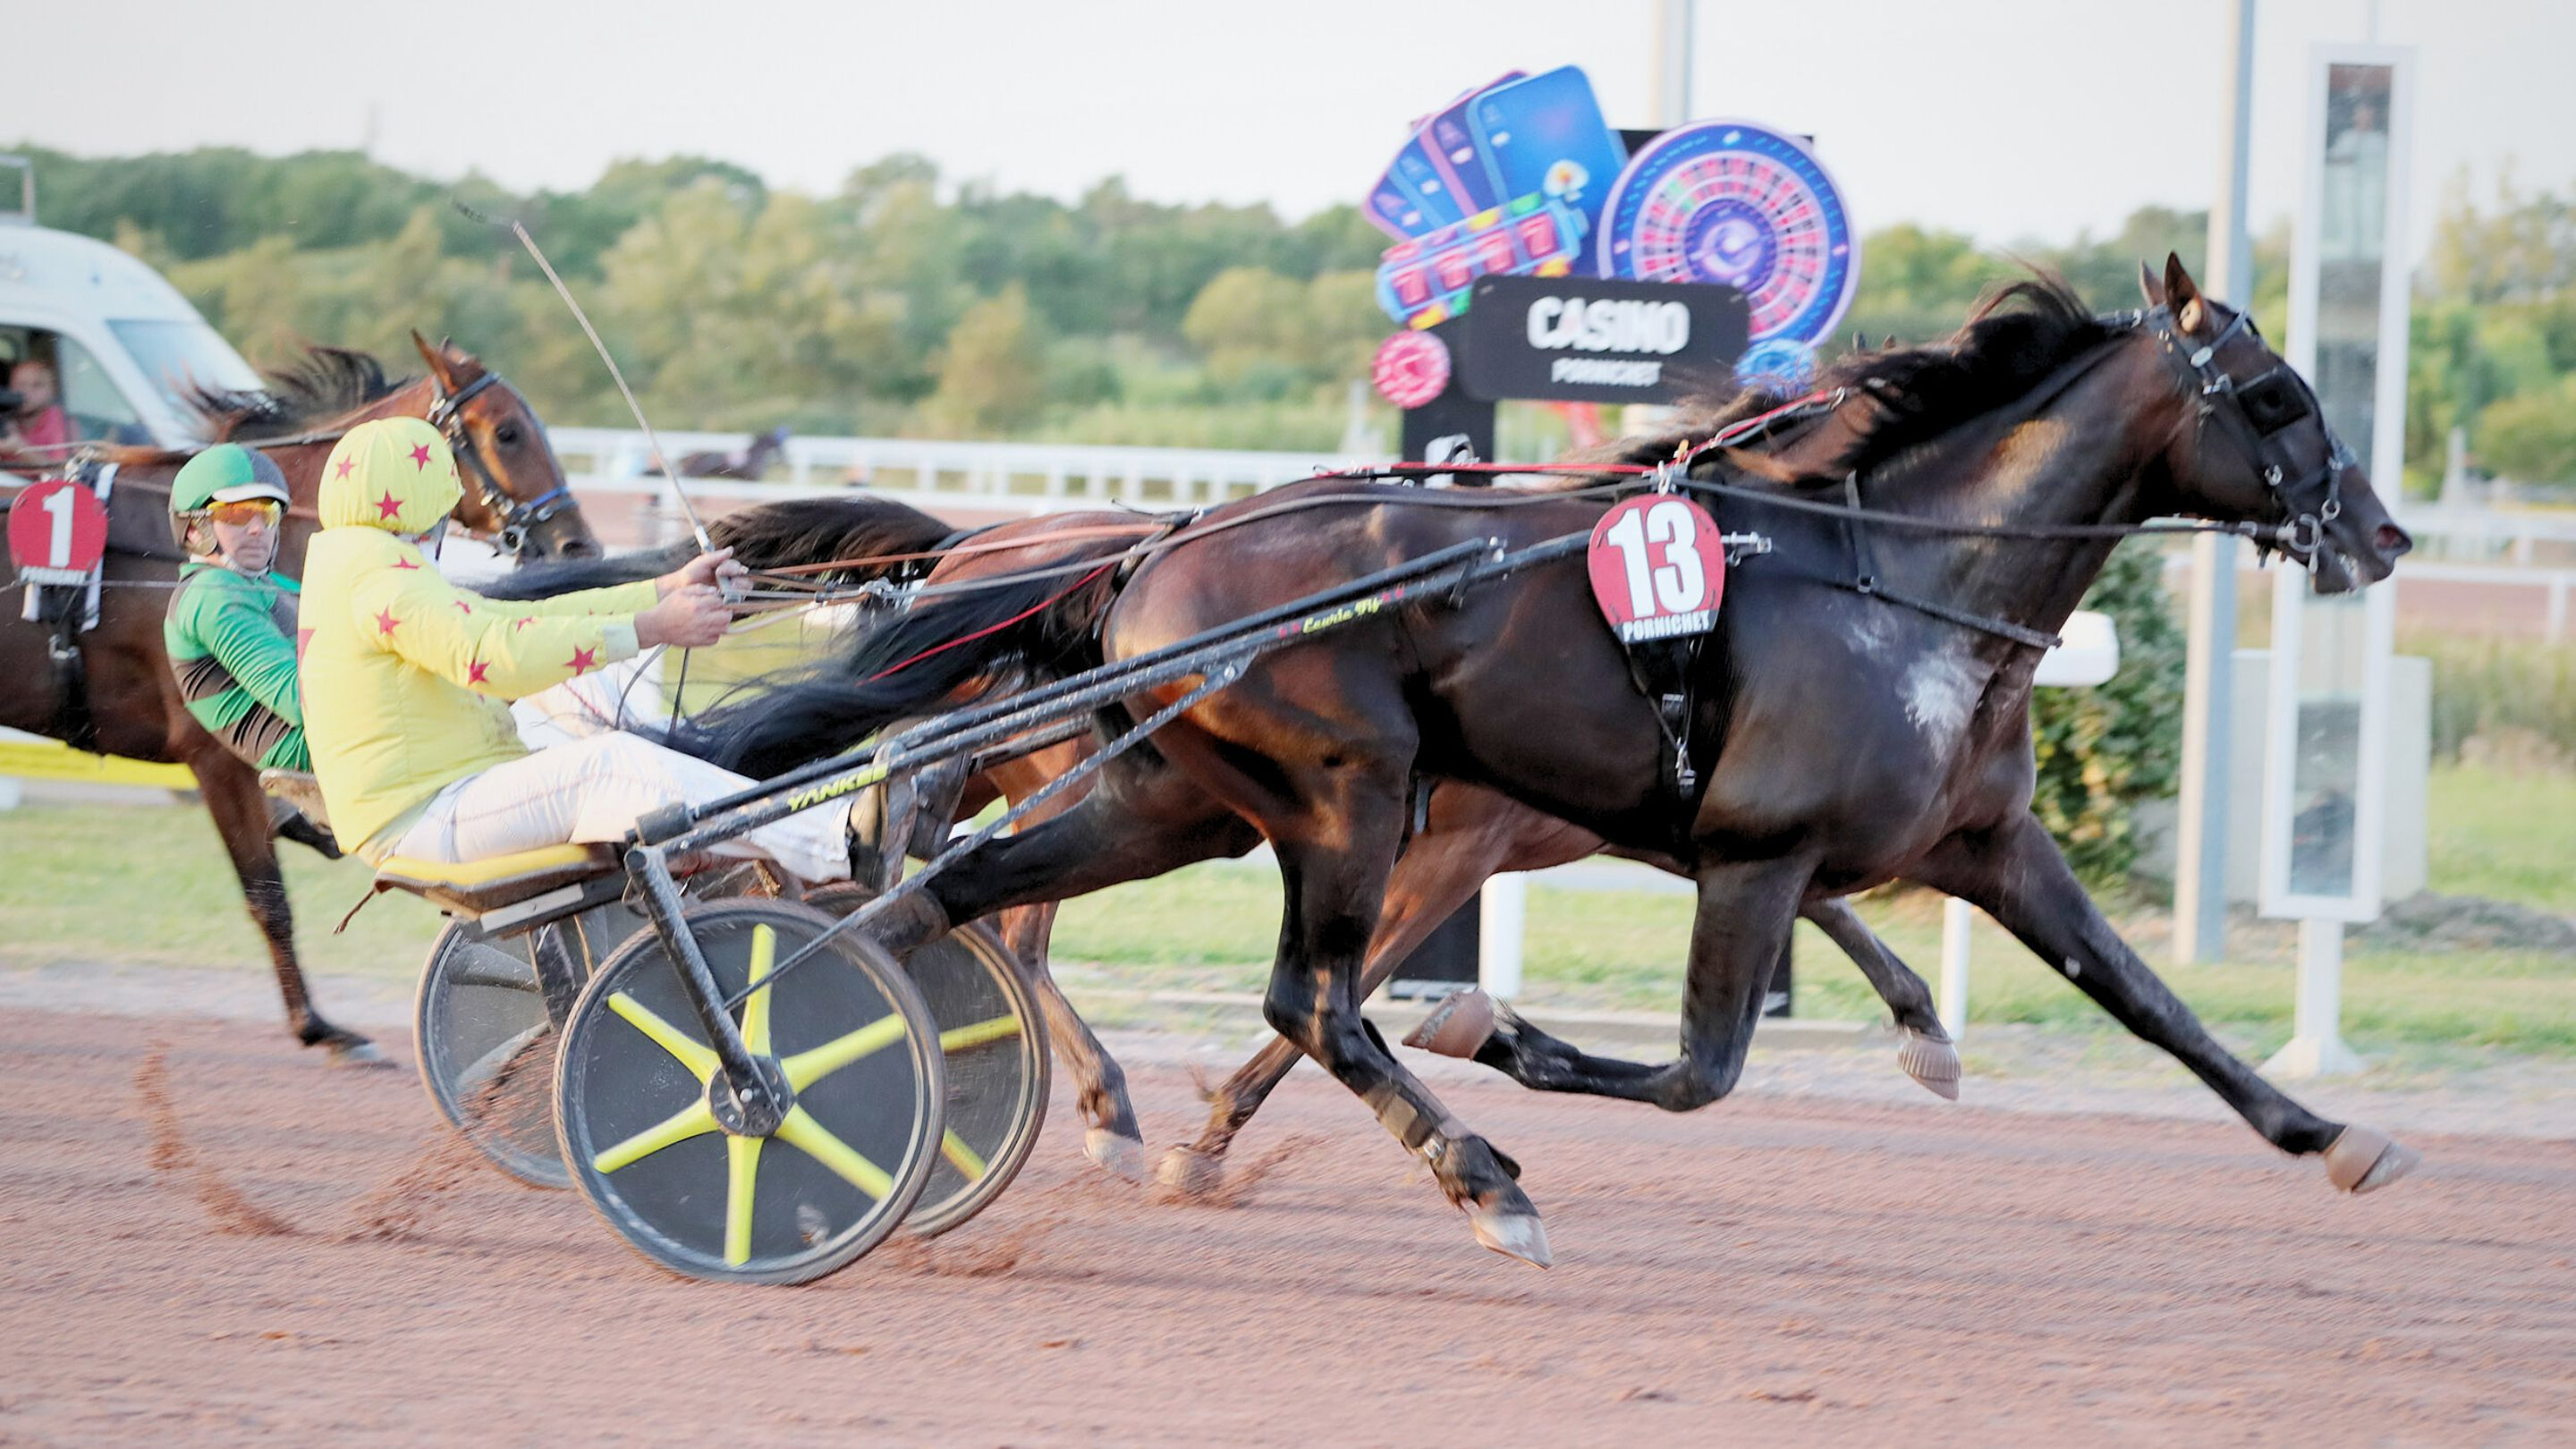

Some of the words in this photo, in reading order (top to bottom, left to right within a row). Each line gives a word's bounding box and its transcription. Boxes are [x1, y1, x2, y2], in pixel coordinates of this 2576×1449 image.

[1527, 296, 1690, 354] CASINO
[43, 486, 75, 568] 1
[1607, 500, 1705, 618] 13
[1622, 609, 1710, 641] PORNICHET
